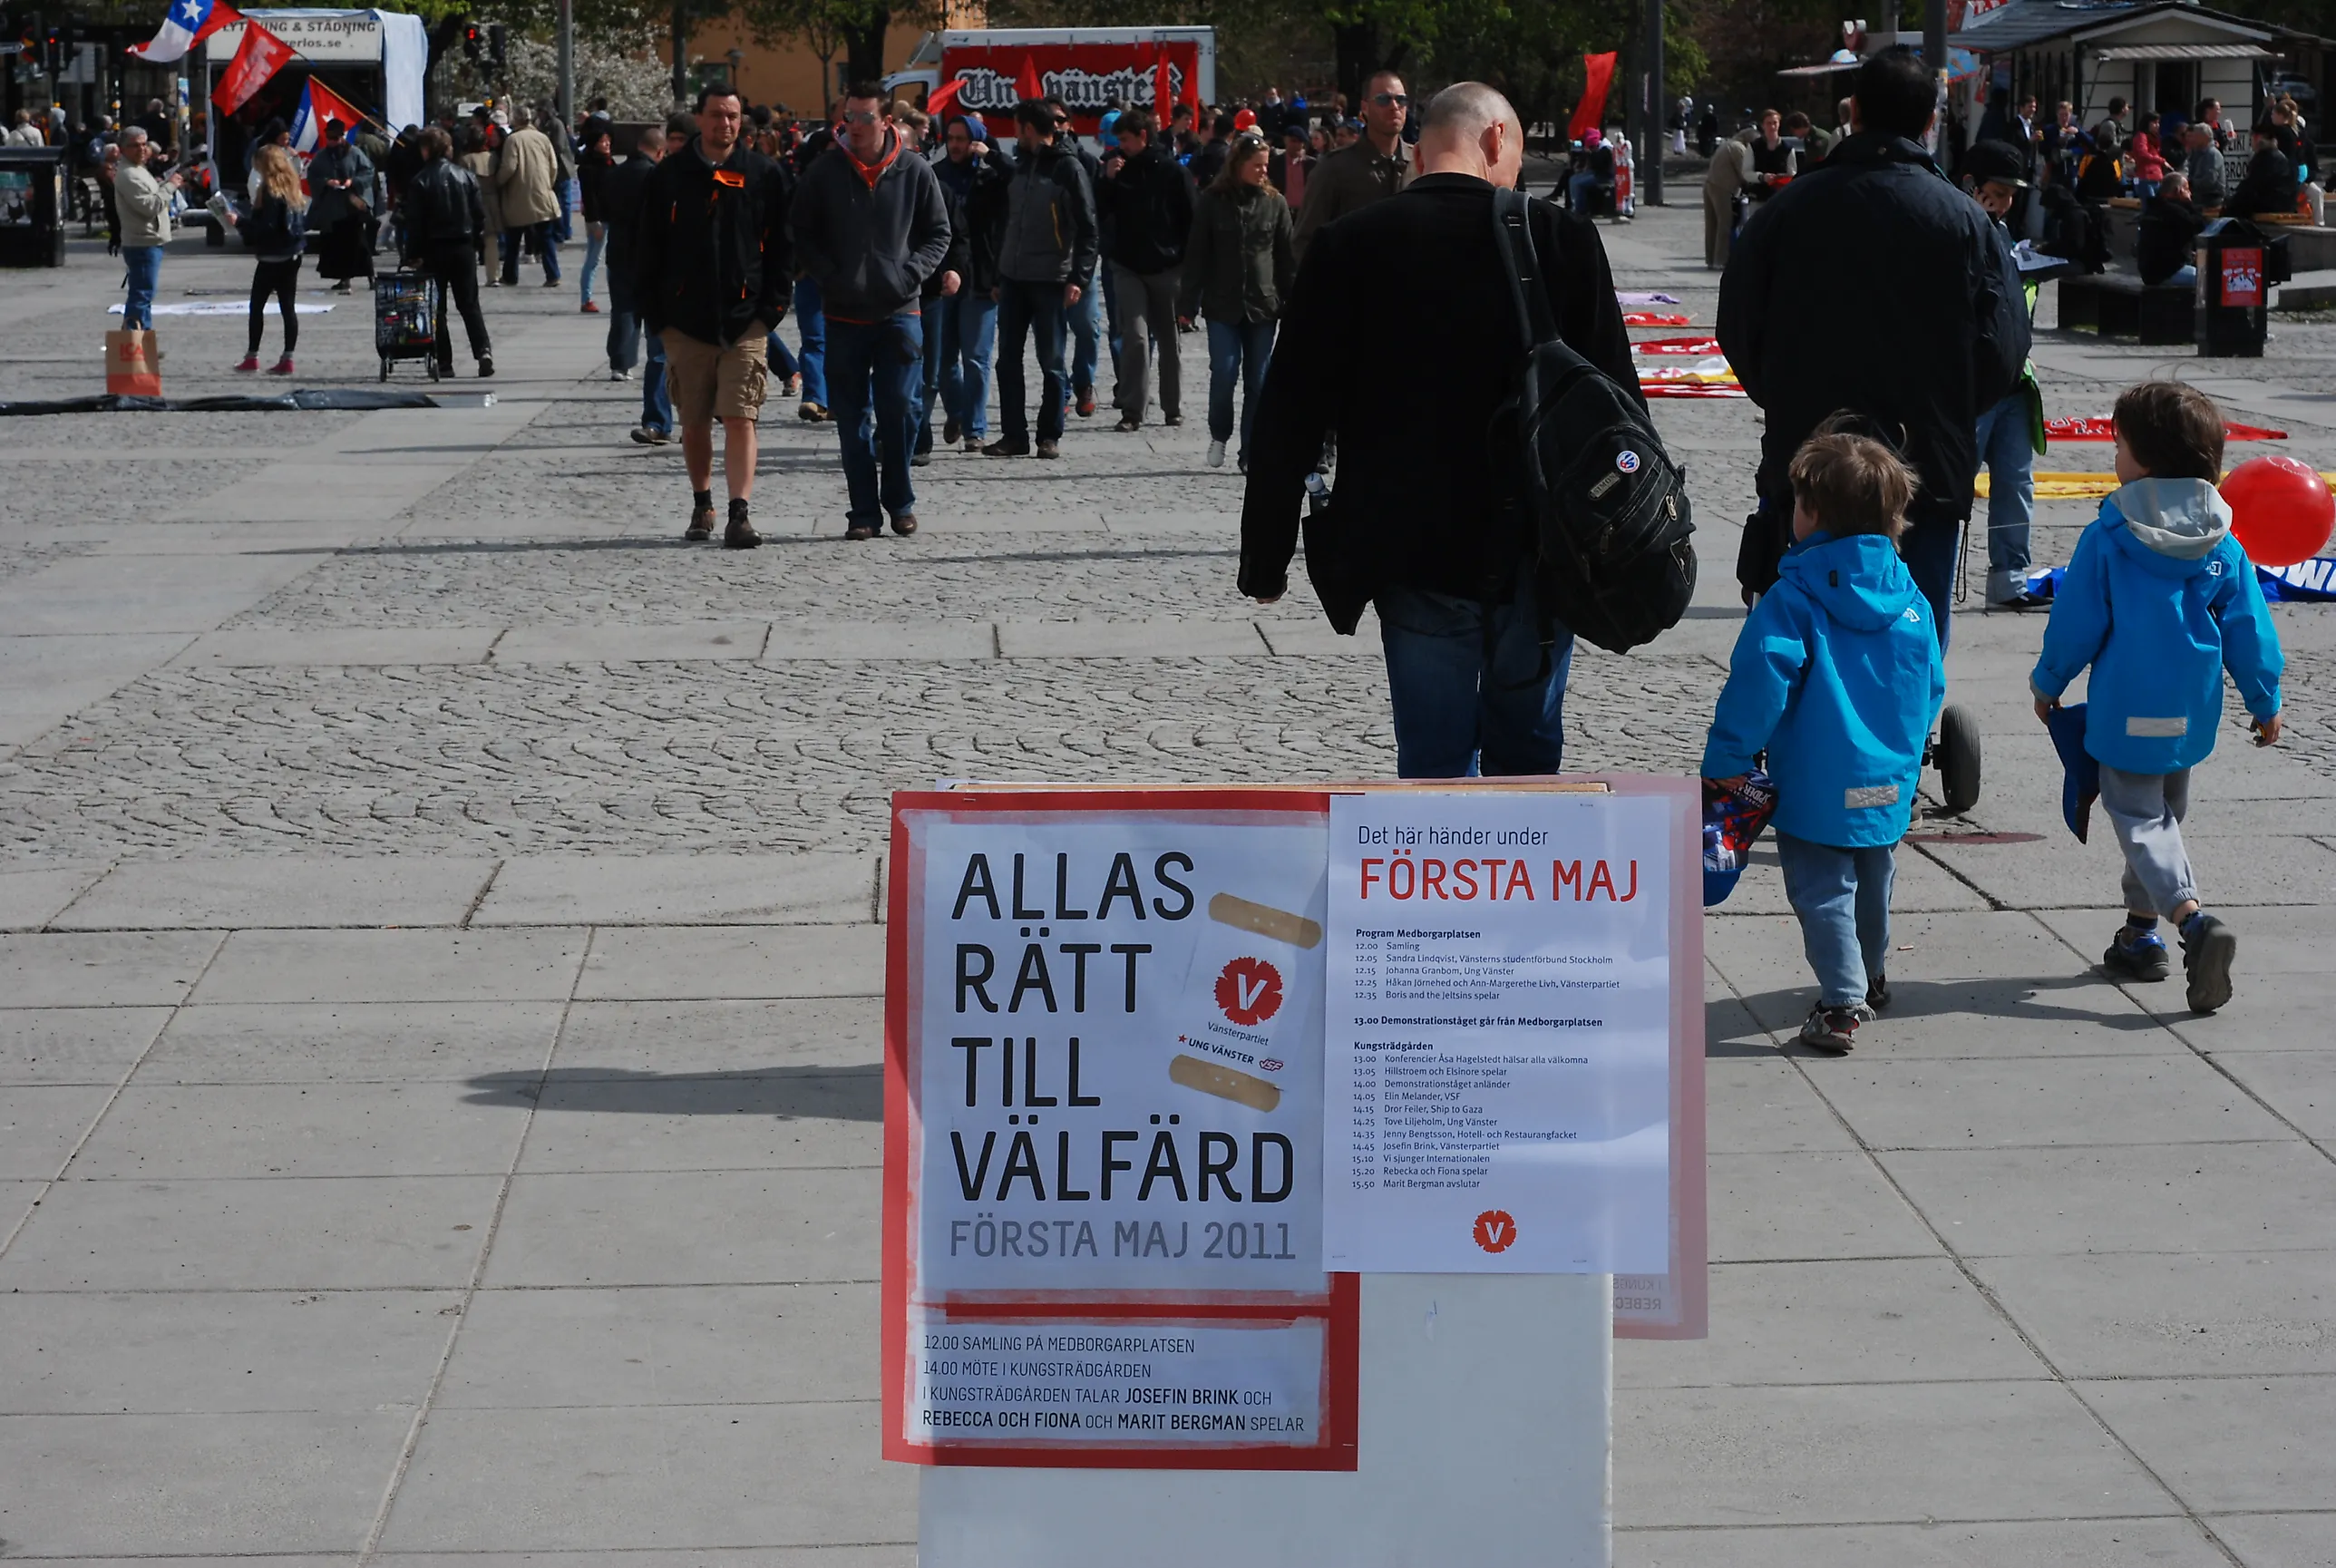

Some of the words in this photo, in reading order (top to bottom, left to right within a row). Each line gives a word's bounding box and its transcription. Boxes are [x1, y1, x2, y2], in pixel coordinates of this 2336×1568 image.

[292, 22, 302, 33] &
[307, 19, 375, 33] STÄDNING
[957, 69, 1018, 107] Un
[1743, 784, 1771, 805] SPIDER
[1359, 826, 1388, 843] Det
[1396, 826, 1423, 844] här
[1430, 826, 1491, 844] händer
[1498, 827, 1548, 844] under
[1361, 849, 1534, 901] FÖRSTA
[1553, 860, 1637, 901] MAJ
[951, 852, 1193, 920] ALLAS
[1356, 929, 1395, 940] Program
[1397, 929, 1481, 940] Medborgarplatsen
[1387, 941, 1420, 952] Samling
[1356, 955, 1377, 964] 12.05
[1386, 953, 1416, 962] Sandra
[1417, 954, 1458, 964] Lindqvist,
[1459, 954, 1501, 963] Vänsterns
[1502, 955, 1567, 964] studentförbund
[1569, 955, 1613, 964] Stockholm
[956, 927, 1152, 1013] RÄTT
[1355, 967, 1377, 976] 12.15
[1386, 966, 1420, 976] Johanna
[1421, 966, 1463, 976] Granbom,
[1464, 967, 1481, 977] Ung
[1482, 967, 1514, 976] Vänster
[1355, 979, 1377, 989] 12.25
[1386, 978, 1412, 987] Håkan
[1414, 979, 1452, 988] Jörnehed
[1453, 979, 1468, 988] och
[1539, 979, 1559, 989] Livh,
[1560, 979, 1620, 990] Vänsterpartiet
[1237, 973, 1268, 1010] V
[1355, 991, 1377, 1000] 12.35
[1386, 990, 1407, 999] Boris
[1408, 990, 1425, 999] and
[1426, 990, 1441, 999] the
[1442, 990, 1473, 1000] Jeltsins
[1474, 990, 1500, 1001] spelar
[1354, 1017, 1379, 1027] 13.00
[1381, 1016, 1477, 1027] Demonstrationståget
[1479, 1016, 1495, 1027] går
[1496, 1016, 1515, 1026] från
[1517, 1017, 1602, 1028] Medborgarplatsen
[1208, 1021, 1269, 1046] Vänsterpartiet
[1189, 1038, 1209, 1051] UNG
[1212, 1045, 1254, 1064] VÄNSTER
[1354, 1041, 1434, 1053] Kungsträdgården
[1354, 1056, 1377, 1065] 13.00
[1385, 1054, 1437, 1063] Konferencier
[1438, 1053, 1454, 1064] Åsa
[1455, 1055, 1501, 1066] Hagelstedt
[1503, 1055, 1529, 1064] hälsar
[1530, 1055, 1546, 1064] alla
[1547, 1056, 1589, 1065] välkomna
[951, 1037, 1100, 1106] TILL
[1354, 1068, 1376, 1077] 13.05
[1384, 1066, 1427, 1076] Hillstroem
[1428, 1066, 1445, 1076] och
[1445, 1066, 1480, 1076] Elsinore
[1481, 1066, 1507, 1077] spelar
[1353, 1080, 1377, 1089] 14.00
[1384, 1079, 1472, 1090] Demonstrationståget
[1473, 1079, 1511, 1089] anländer
[1353, 1093, 1376, 1102] 14.05
[1384, 1091, 1400, 1101] Elin
[1401, 1092, 1443, 1102] Melander,
[1444, 1092, 1461, 1101] VSF
[1353, 1105, 1375, 1115] 14.15
[1384, 1104, 1403, 1114] Dror
[1404, 1105, 1429, 1115] Feiler,
[1430, 1105, 1450, 1115] Ship
[1451, 1105, 1461, 1114] to
[1462, 1105, 1483, 1114] Gaza
[1353, 1118, 1376, 1127] 14.25
[1384, 1116, 1403, 1125] Tove
[1405, 1116, 1445, 1127] Liljeholm,
[1446, 1117, 1464, 1128] Ung
[1465, 1117, 1498, 1126] Vänster
[1353, 1131, 1375, 1140] 14.35
[1383, 1129, 1407, 1140] Jenny
[1408, 1129, 1455, 1140] Bengtsson,
[1457, 1130, 1485, 1139] Hotell-
[1486, 1130, 1503, 1139] och
[1504, 1130, 1577, 1141] Restaurangfacket
[1352, 1143, 1375, 1152] 14.45
[1383, 1141, 1412, 1151] Josefin
[1414, 1142, 1438, 1151] Brink,
[1439, 1142, 1500, 1152] Vänsterpartiet
[950, 1115, 1293, 1203] VÄLFÄRD
[1352, 1155, 1374, 1164] 15.10
[1383, 1154, 1392, 1163] Vi
[1393, 1154, 1425, 1164] sjunger
[1426, 1154, 1490, 1163] Internationalen
[1352, 1168, 1375, 1177] 15.20
[1383, 1166, 1418, 1175] Rebecka
[1420, 1166, 1436, 1175] och
[1437, 1166, 1460, 1175] Fiona
[1462, 1166, 1488, 1177] spelar
[1352, 1181, 1375, 1190] 15.50
[1383, 1179, 1406, 1188] Marit
[1406, 1179, 1445, 1190] Bergman
[1445, 1179, 1481, 1188] avslutar
[951, 1213, 1097, 1257] FÖRSTA
[1114, 1221, 1187, 1258] MAJ
[1203, 1222, 1295, 1260] 2011
[1485, 1222, 1504, 1243] V
[925, 1335, 959, 1349] 12.00
[963, 1337, 1021, 1350] SAMLING
[1027, 1335, 1043, 1350] PÅ
[1048, 1338, 1193, 1352] MEDBORGARPLATSEN
[924, 1360, 957, 1375] 14.00
[963, 1359, 998, 1376] MÖTE
[1011, 1361, 1150, 1378] KUNGSTRÄDGÅRDEN
[931, 1386, 1069, 1402] KUNGSTRÄDGÅRDEN
[1076, 1389, 1119, 1403] TALAR
[1125, 1388, 1186, 1404] JOSEFIN
[1193, 1389, 1239, 1404] BRINK
[1244, 1391, 1270, 1405] OCH
[923, 1410, 993, 1427] REBECCA
[999, 1412, 1028, 1427] OCH
[1036, 1413, 1080, 1427] FIONA
[1086, 1416, 1112, 1428] OCH
[1119, 1414, 1165, 1429] MARIT
[1172, 1415, 1245, 1430] BERGMAN
[1251, 1417, 1303, 1431] SPELAR
